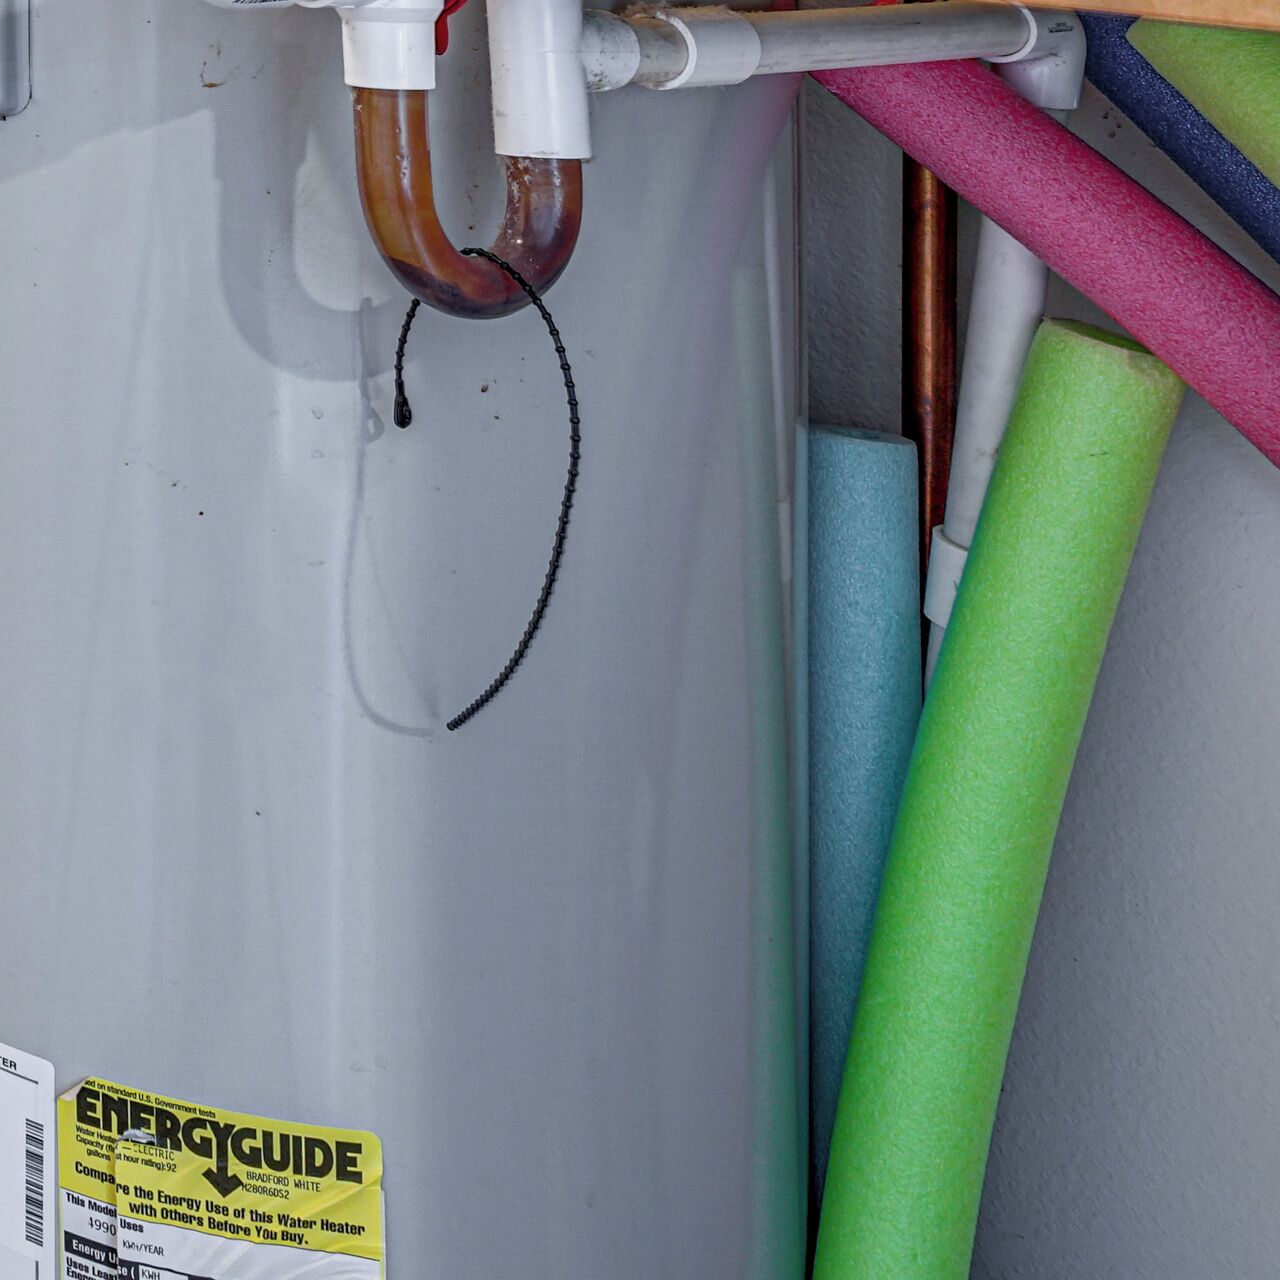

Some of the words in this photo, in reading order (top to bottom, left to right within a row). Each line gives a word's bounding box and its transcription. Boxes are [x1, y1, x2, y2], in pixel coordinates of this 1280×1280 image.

[107, 1085, 138, 1100] standard
[138, 1093, 154, 1105] U.S.
[154, 1097, 198, 1115] Government
[198, 1107, 216, 1119] tests
[75, 1135, 104, 1151] Capacity
[123, 1154, 140, 1166] hour
[76, 1086, 363, 1186] ENERGYGUIDE
[86, 1148, 112, 1162] gallons
[246, 1171, 290, 1187] BRADFORD
[293, 1179, 321, 1193] WHITE
[66, 1191, 86, 1209] This
[87, 1196, 118, 1219] Model
[119, 1217, 145, 1234] Uses
[128, 1201, 157, 1219] with
[160, 1207, 204, 1228] Others
[208, 1213, 252, 1237] Before
[255, 1225, 279, 1241] You
[280, 1229, 309, 1247] Buy.
[134, 1185, 154, 1202] the
[157, 1189, 202, 1212] Energy
[205, 1200, 229, 1217] Use
[233, 1207, 246, 1219] of
[249, 1209, 274, 1225] this
[277, 1213, 317, 1230] Water
[320, 1218, 366, 1237] Heater
[66, 1256, 90, 1273] Uses
[71, 1239, 107, 1261] Energy
